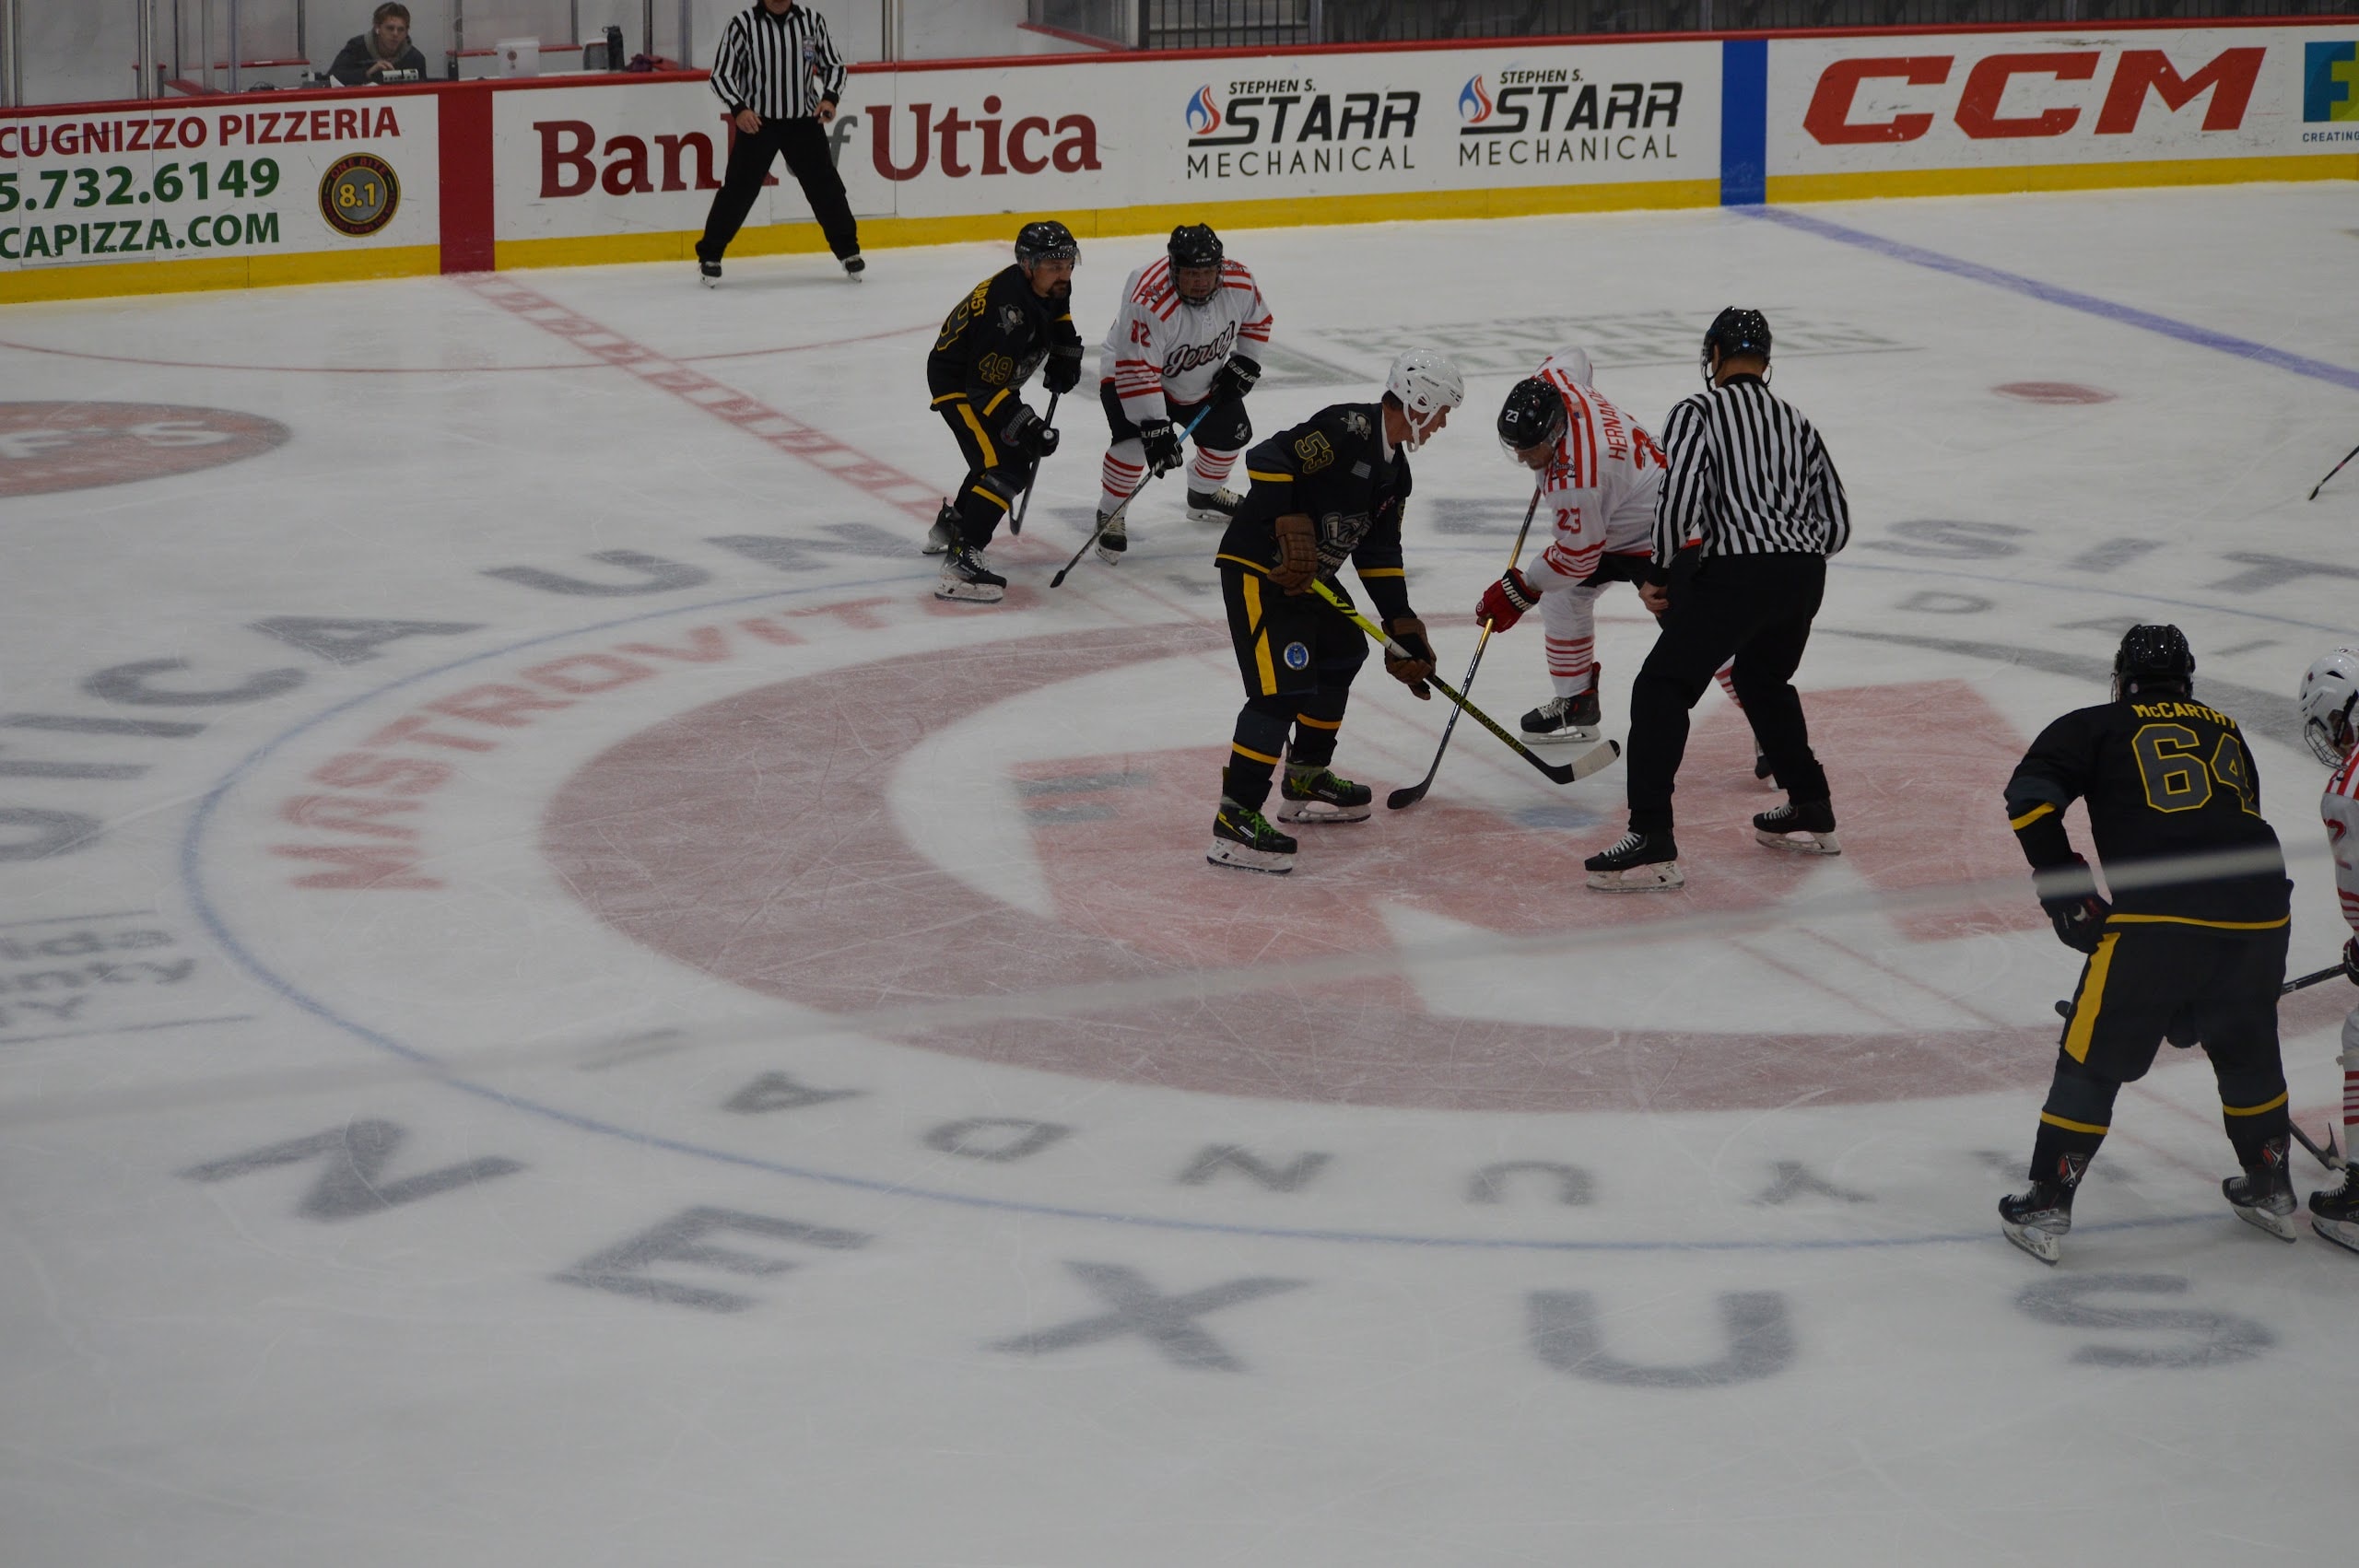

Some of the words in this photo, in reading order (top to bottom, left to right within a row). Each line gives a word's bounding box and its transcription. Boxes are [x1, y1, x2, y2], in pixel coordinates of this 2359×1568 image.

[1228, 79, 1299, 95] STEPHEN
[1304, 78, 1317, 91] S.
[1499, 69, 1568, 86] STEPHEN
[1571, 68, 1584, 82] S.
[1802, 46, 2268, 146] CCM
[1188, 91, 1421, 146] STARR
[1459, 81, 1684, 136] STARR
[0, 116, 207, 158] CUGNIZZO
[219, 106, 401, 146] PIZZERIA
[864, 95, 1102, 181] Utica
[1459, 135, 1678, 168] MECHANICAL
[2302, 129, 2359, 143] CREATING
[331, 158, 355, 179] ONE
[360, 158, 388, 176] BITE
[1187, 145, 1415, 180] MECHANICAL
[0, 157, 280, 213] 5.732.6149
[339, 182, 375, 207] 8.1
[0, 211, 280, 260] CAPIZZA.COM
[978, 352, 1015, 386] 49
[1163, 321, 1236, 379] Jersey
[1505, 409, 1520, 423] 23
[1295, 430, 1334, 474] 53
[1556, 508, 1581, 533] 23
[2131, 723, 2262, 819] 64
[189, 1117, 2275, 1387] NEXUS
